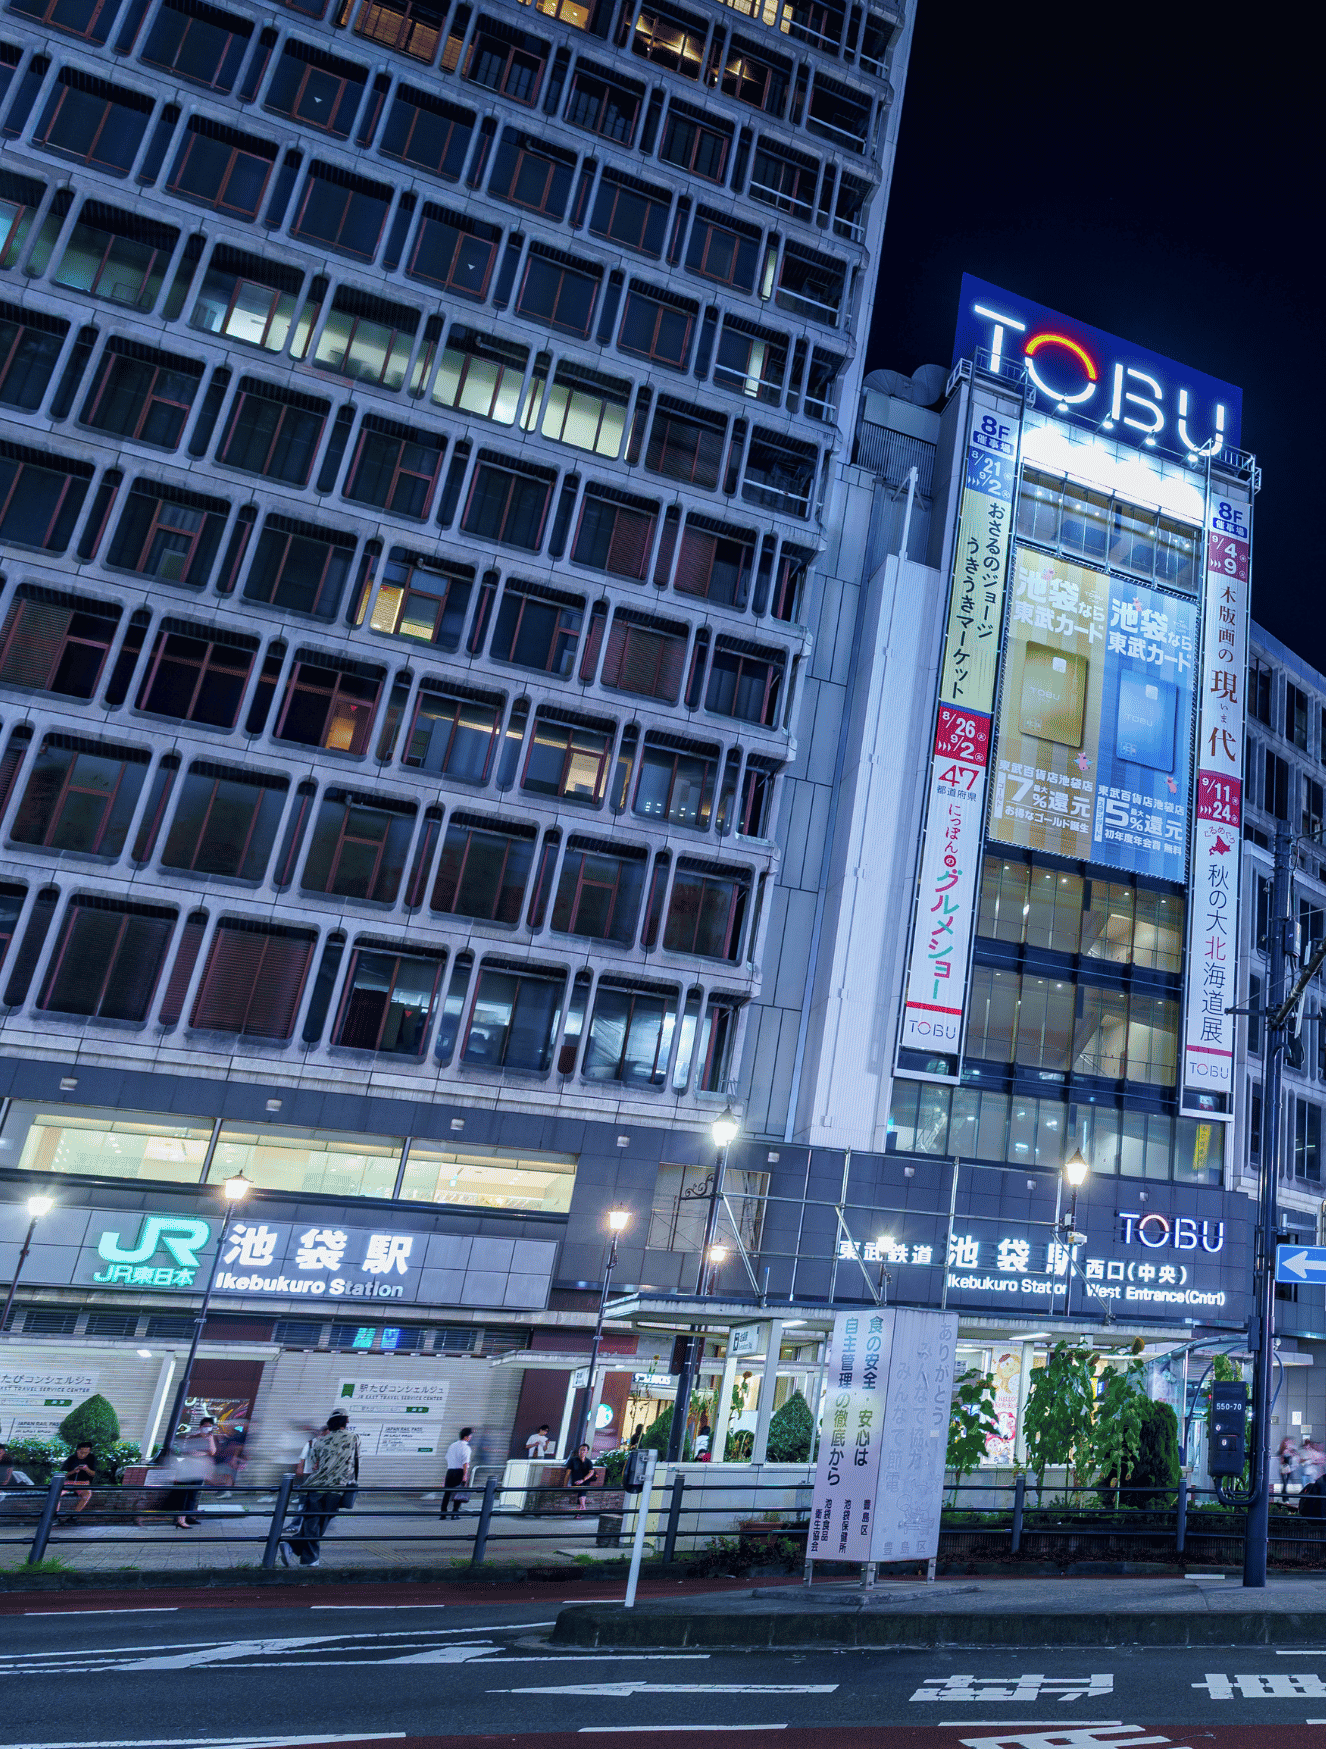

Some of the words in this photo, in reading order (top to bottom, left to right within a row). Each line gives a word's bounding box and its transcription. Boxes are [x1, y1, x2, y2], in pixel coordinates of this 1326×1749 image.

[974, 304, 1224, 457] TOBU
[981, 415, 1010, 438] 8F
[971, 451, 1001, 477] 8/21
[979, 472, 1001, 496] 9/2
[1219, 502, 1243, 523] 8F
[1212, 535, 1238, 559] 9/4
[977, 502, 1006, 639] おさるのジョージ
[1016, 566, 1105, 622] 池袋なら
[953, 535, 980, 699] うきうきマーケット
[1012, 600, 1104, 644] 東武カード
[1110, 598, 1192, 651] 池袋なら
[1108, 631, 1192, 673] 東武カード
[942, 711, 976, 738] 8/26
[950, 734, 975, 760] 9/2
[999, 759, 1094, 793] 東武百貨店池袋店
[1202, 777, 1230, 803] 9/11
[936, 785, 977, 802] 都道府県
[1098, 784, 1185, 816] 東武百貨店池袋店
[1005, 805, 1089, 834] お得なゴールド誕生
[1213, 801, 1231, 822] 24
[928, 868, 963, 1000] グルメショー
[1200, 863, 1229, 1044] 秋の大北海道展
[909, 1019, 956, 1039] TOBU
[1189, 1062, 1229, 1080] TOBU
[98, 1216, 210, 1267] JR
[1118, 1212, 1223, 1253] TOBU
[224, 1223, 413, 1275] 池袋駅
[839, 1239, 934, 1265] 東武鉄道
[947, 1233, 1077, 1277] 池袋駅
[1085, 1258, 1187, 1285] 西口(中央)
[93, 1264, 197, 1287] JR東日本
[215, 1271, 325, 1294] Ikebukuro
[329, 1278, 404, 1297] Station
[947, 1273, 1018, 1293] Ikebukuro
[1021, 1278, 1068, 1296] Staton
[1125, 1286, 1225, 1306] Entrance(Cntrl)
[360, 1384, 444, 1394] 駅たびコンシェルジュ
[932, 1322, 952, 1426] ありがとう
[827, 1317, 859, 1486] 自主管理の徹底から
[1216, 1402, 1242, 1411] 550-70
